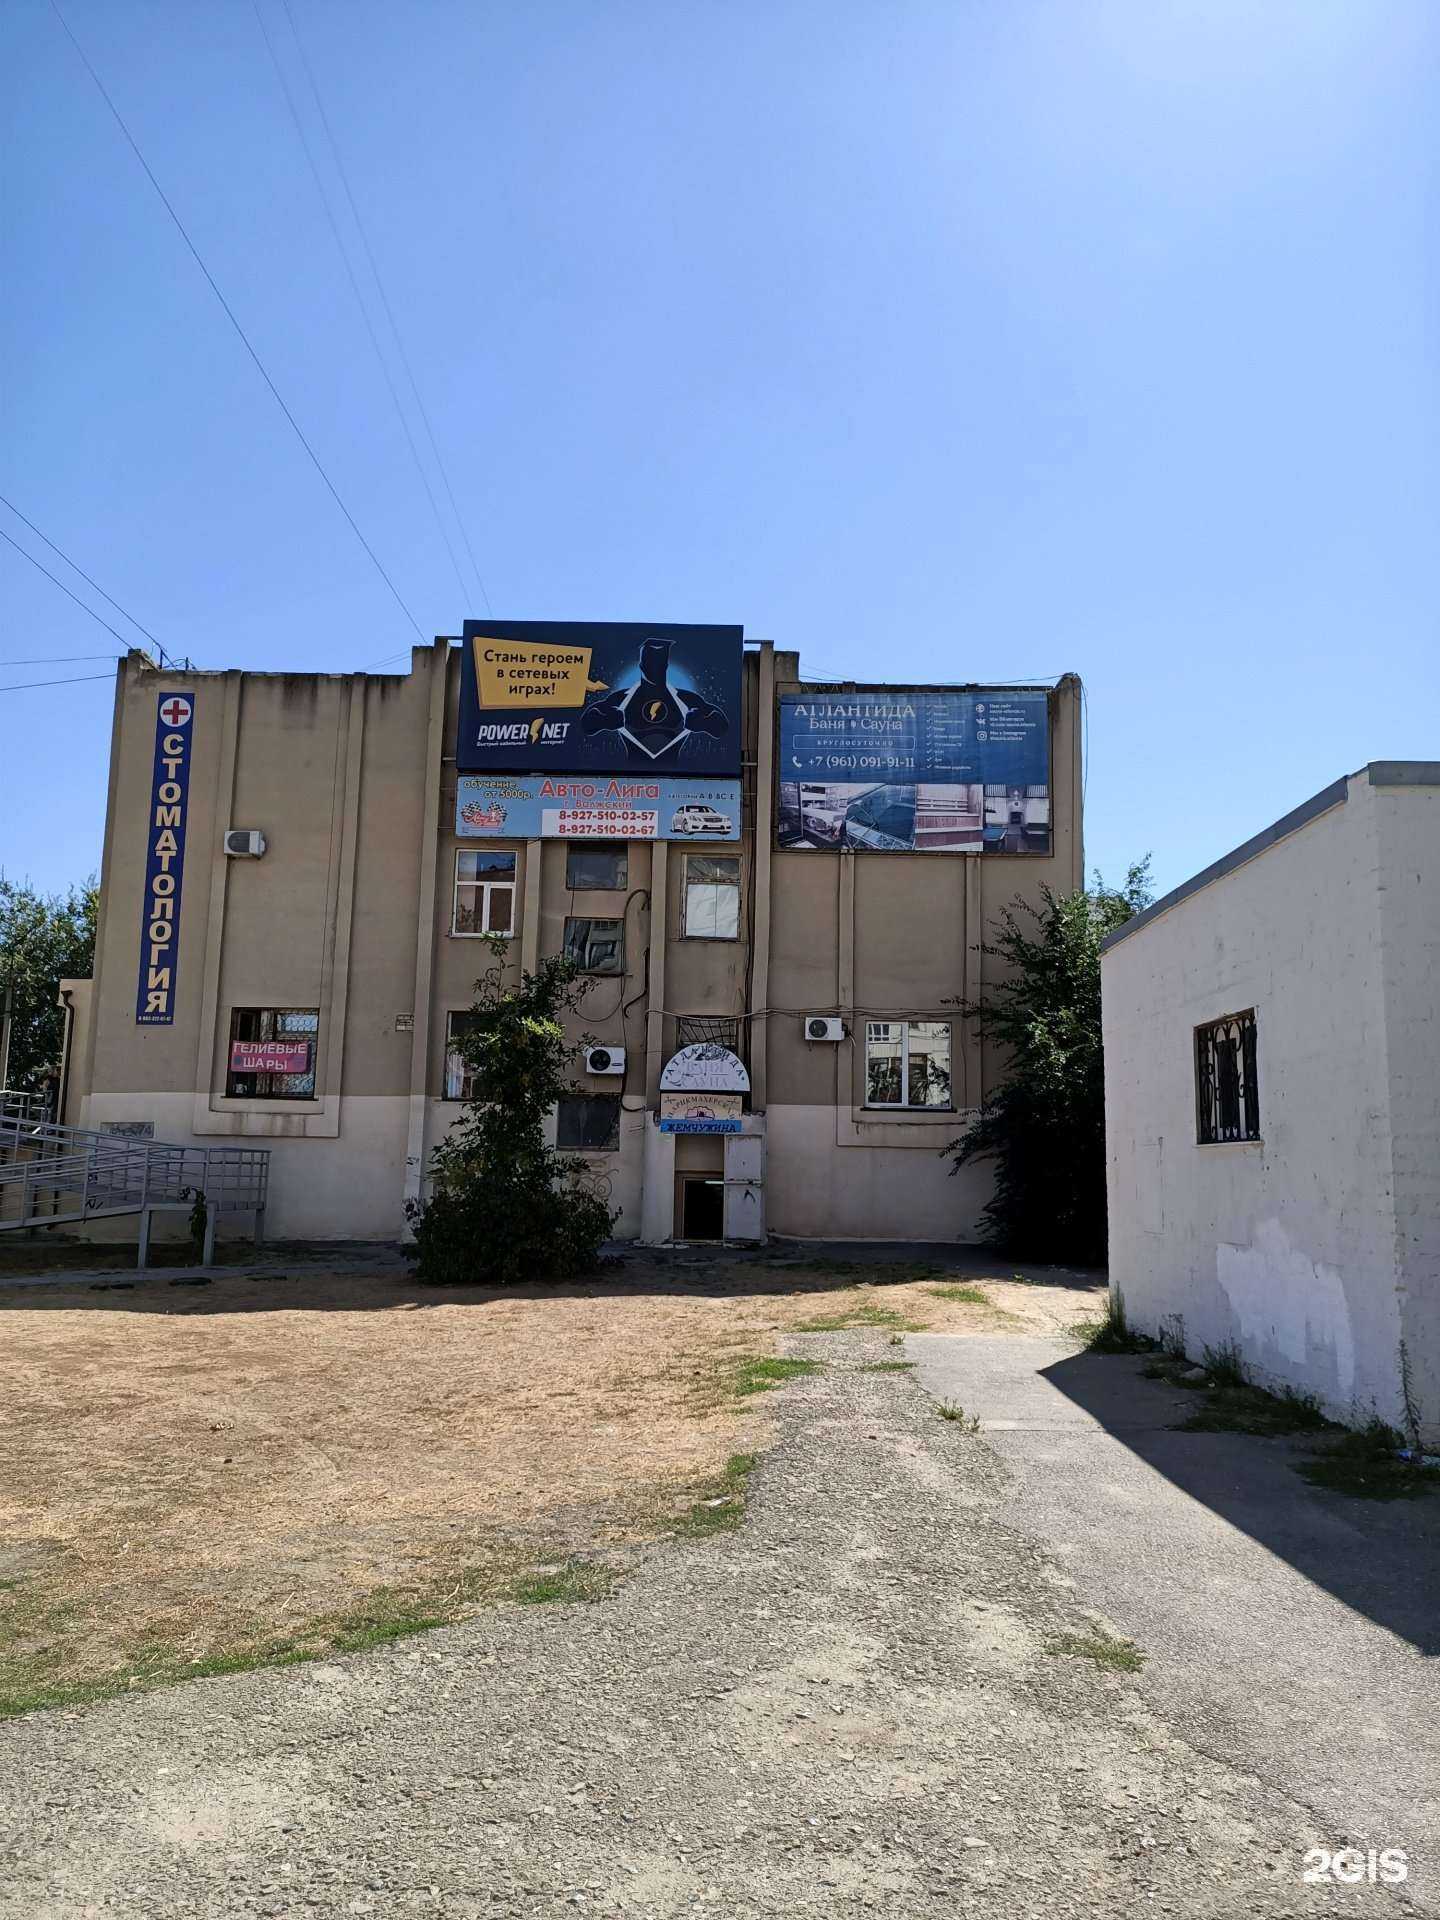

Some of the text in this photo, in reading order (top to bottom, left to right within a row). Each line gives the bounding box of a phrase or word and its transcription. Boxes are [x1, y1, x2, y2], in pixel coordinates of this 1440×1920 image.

[484, 649, 584, 666] Стань героем
[497, 669, 570, 679] в сетевых
[509, 682, 556, 698] играх!
[478, 723, 571, 740] POWER NET
[810, 718, 904, 733] Баня Сауна
[808, 755, 915, 768] +7 (961) 091-91-11
[539, 779, 660, 799] Авто-Лига
[558, 810, 655, 821] 8-927-510-02-57
[558, 824, 655, 835] 8-927-510-02-67
[143, 733, 185, 1013] СТОМАТОЛОГИЯ
[233, 1042, 308, 1054] ГЕЛИЕВЫЕ
